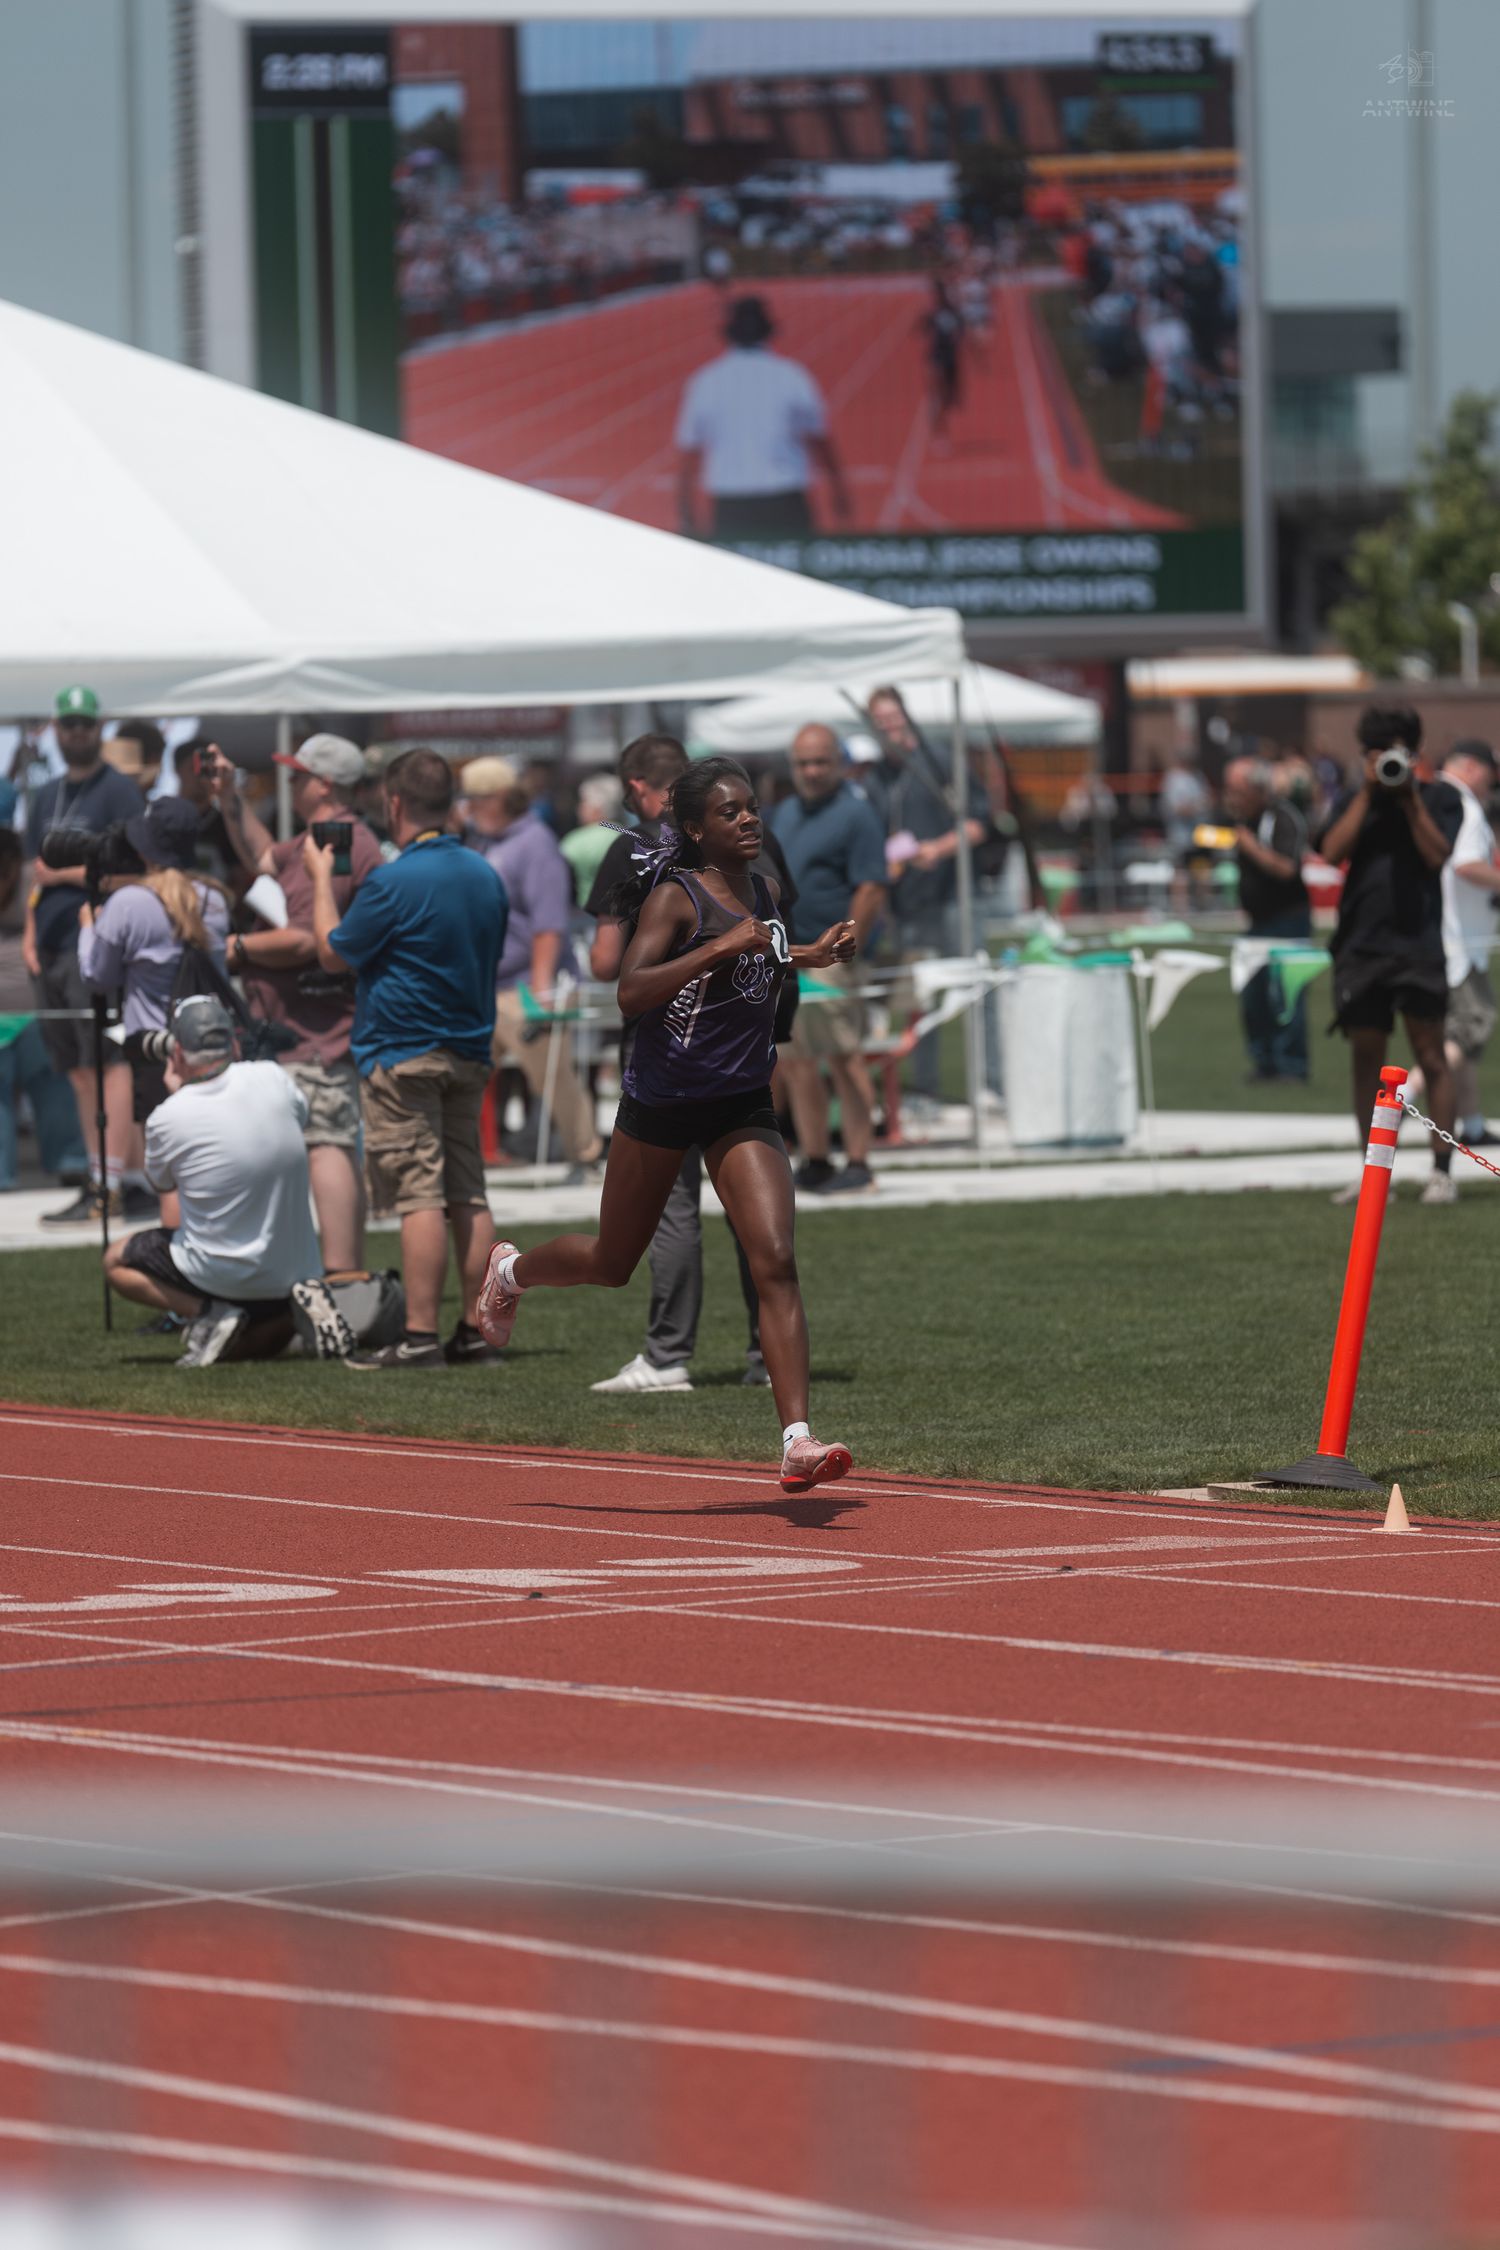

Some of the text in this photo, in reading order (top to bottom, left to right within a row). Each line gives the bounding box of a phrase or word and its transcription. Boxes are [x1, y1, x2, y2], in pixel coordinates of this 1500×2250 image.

[334, 55, 388, 87] PM
[932, 537, 1023, 573] JESSE
[1029, 535, 1162, 570] OWENS
[874, 575, 1156, 612] CHAMPIONSHIPS
[365, 1556, 863, 1588] 2
